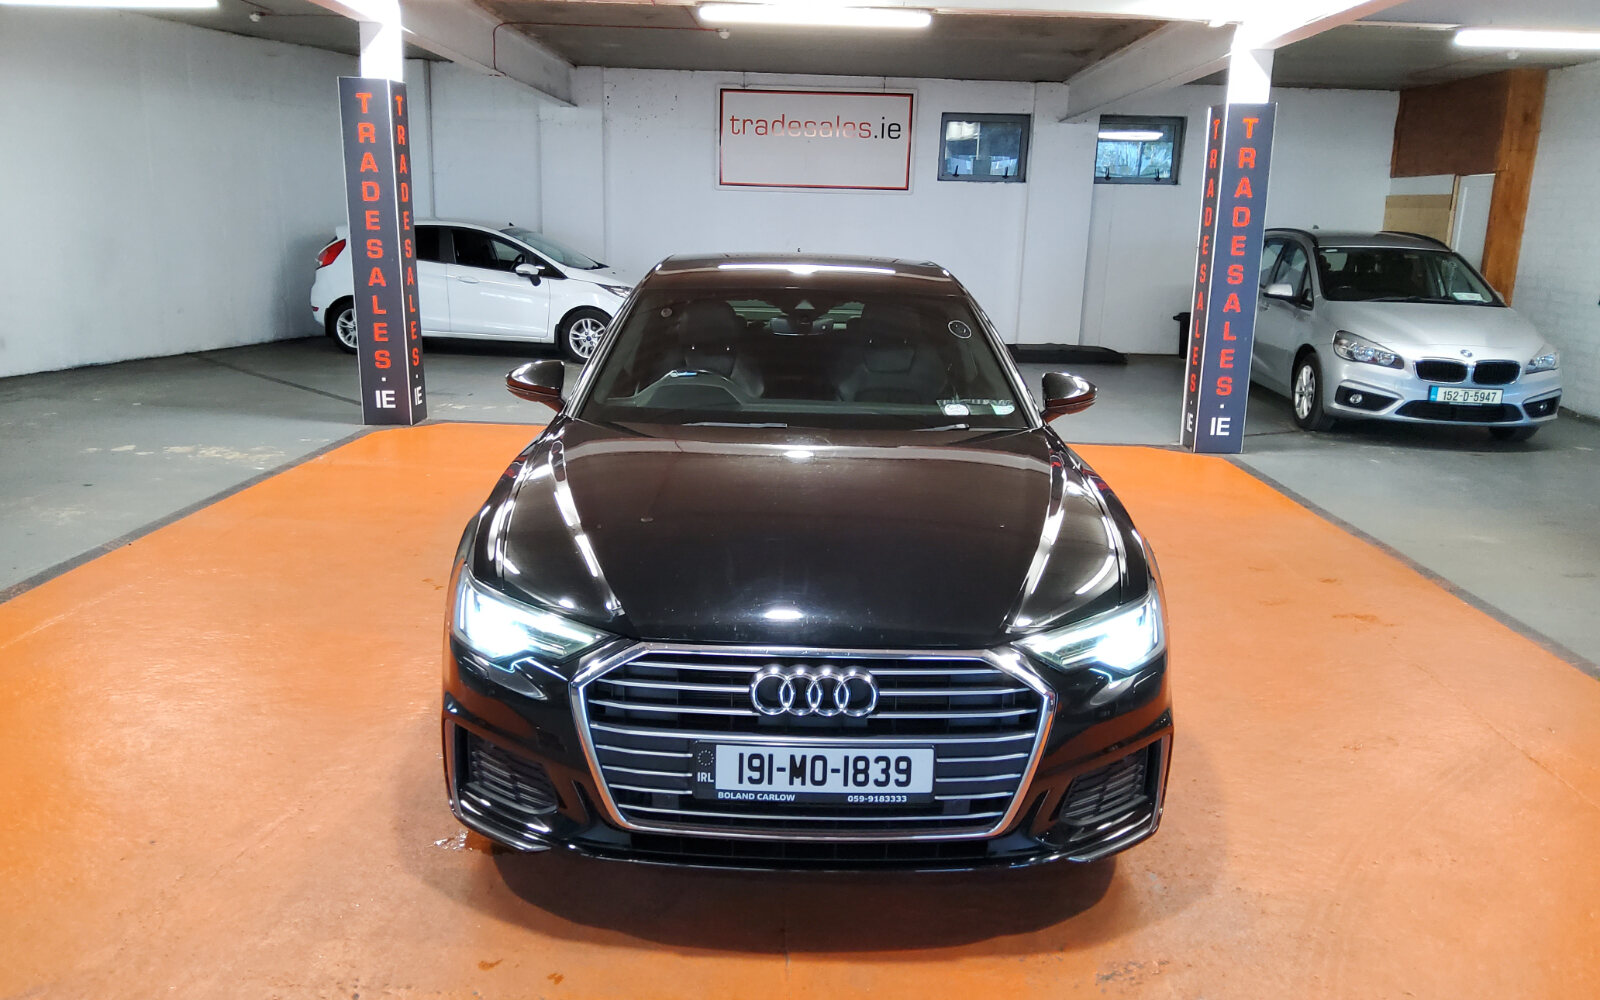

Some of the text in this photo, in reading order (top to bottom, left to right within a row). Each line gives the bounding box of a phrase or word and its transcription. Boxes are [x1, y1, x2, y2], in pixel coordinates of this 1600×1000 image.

[729, 113, 901, 139] tradesales.ie
[1443, 390, 1497, 402] 152-D-5947
[738, 752, 912, 788] 191-MO-1839
[697, 772, 714, 783] IRL
[717, 791, 795, 802] BOLAND CARLOW
[847, 794, 907, 803] 059-9183333
